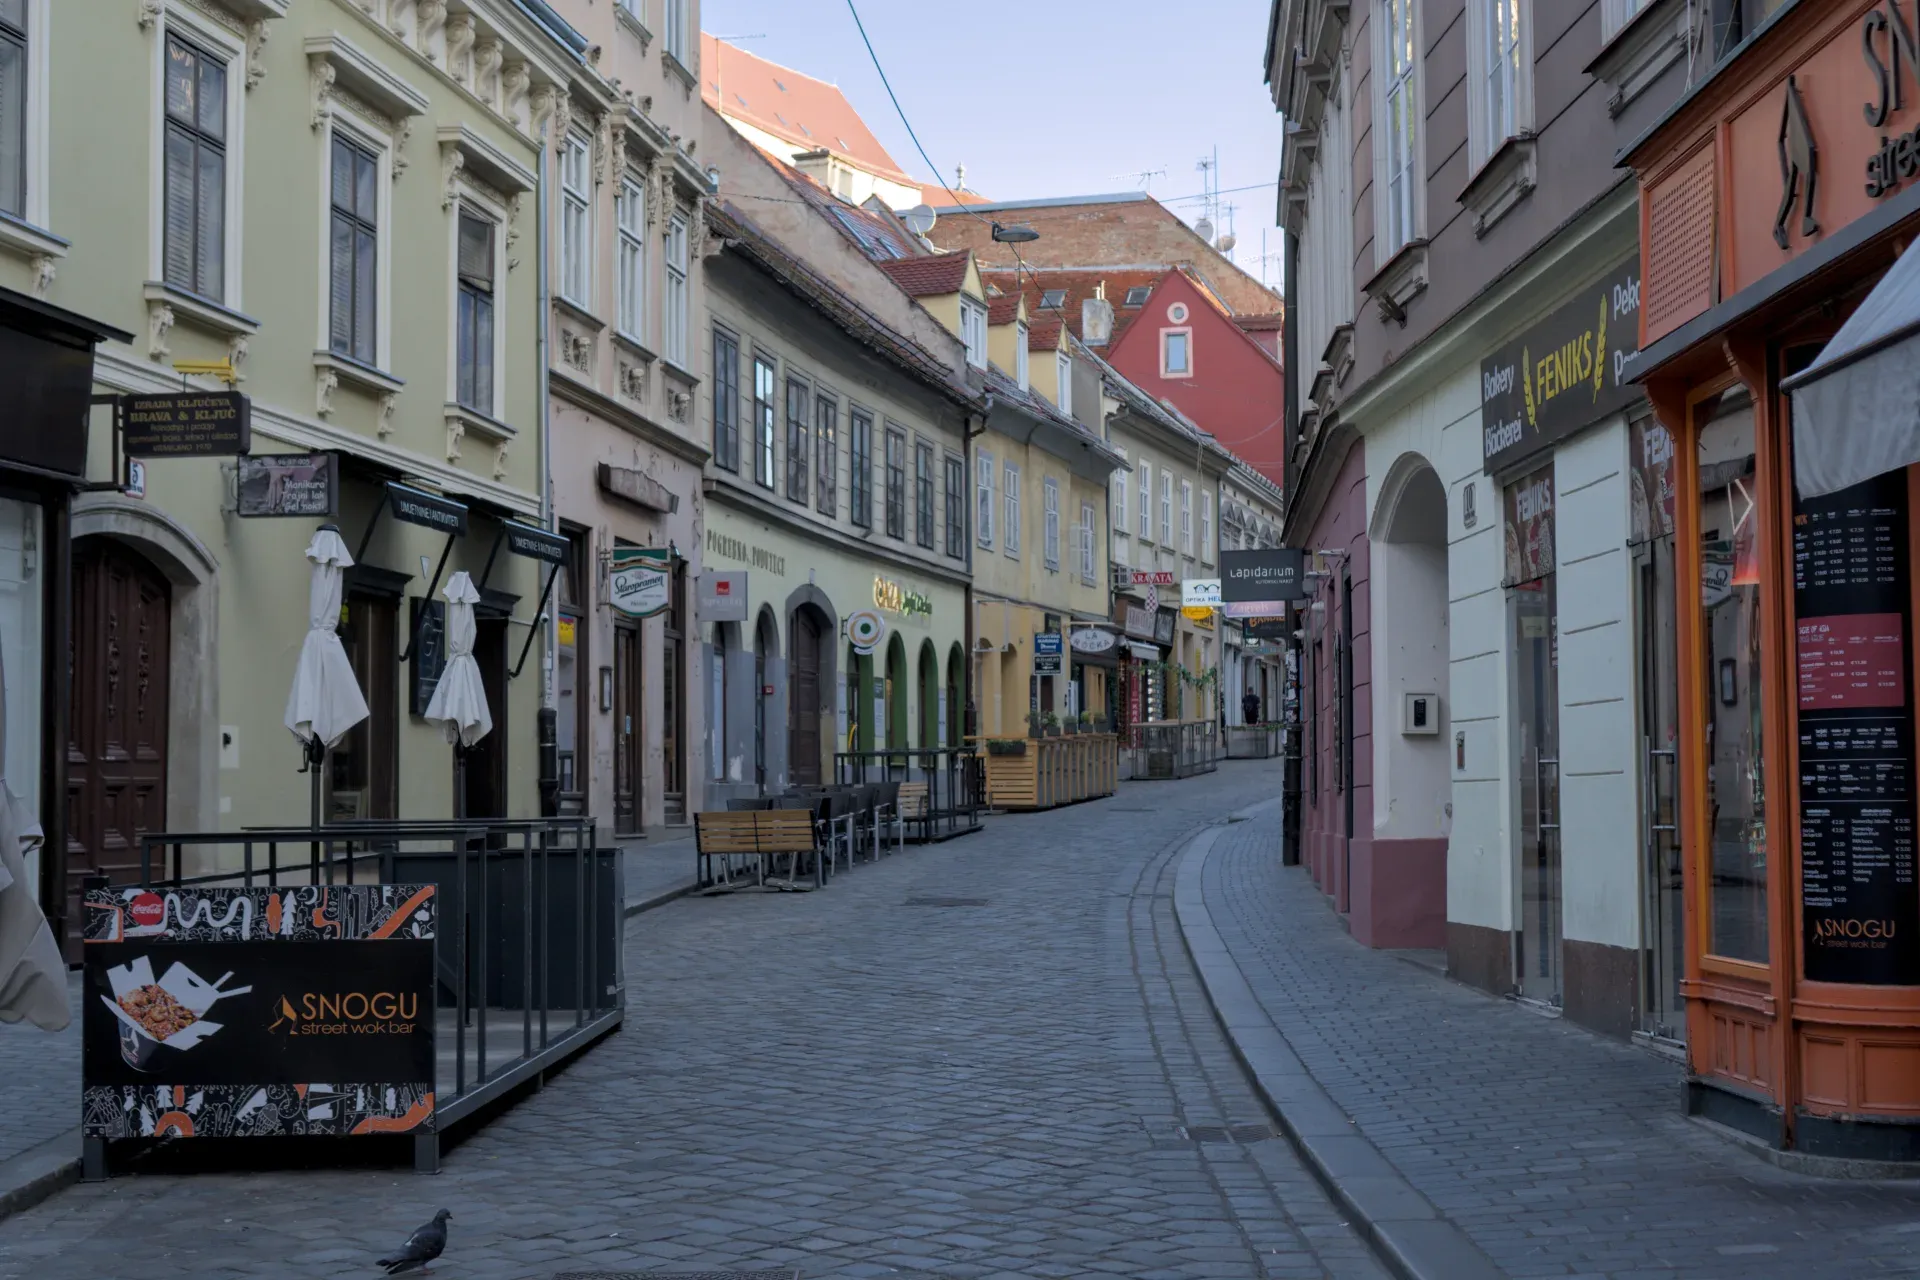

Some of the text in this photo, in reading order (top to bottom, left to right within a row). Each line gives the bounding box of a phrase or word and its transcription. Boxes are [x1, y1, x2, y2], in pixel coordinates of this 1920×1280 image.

[1537, 329, 1594, 406] FENIKS
[1484, 364, 1515, 402] Bakery
[130, 411, 173, 422] BRAVA
[179, 410, 189, 420] &
[1486, 411, 1522, 459] Bäckerei
[285, 479, 326, 490] Manikura
[283, 490, 326, 501] Trajni lak
[284, 501, 325, 511] Gel nokti
[1131, 573, 1173, 584] KRAVATA
[615, 575, 664, 596] Staropramen
[1085, 631, 1098, 640] LA
[1824, 918, 1896, 938] SNOGU
[1827, 939, 1888, 949] street wok bar
[301, 992, 417, 1020] SNOGU
[301, 1021, 416, 1035] street wok bar
